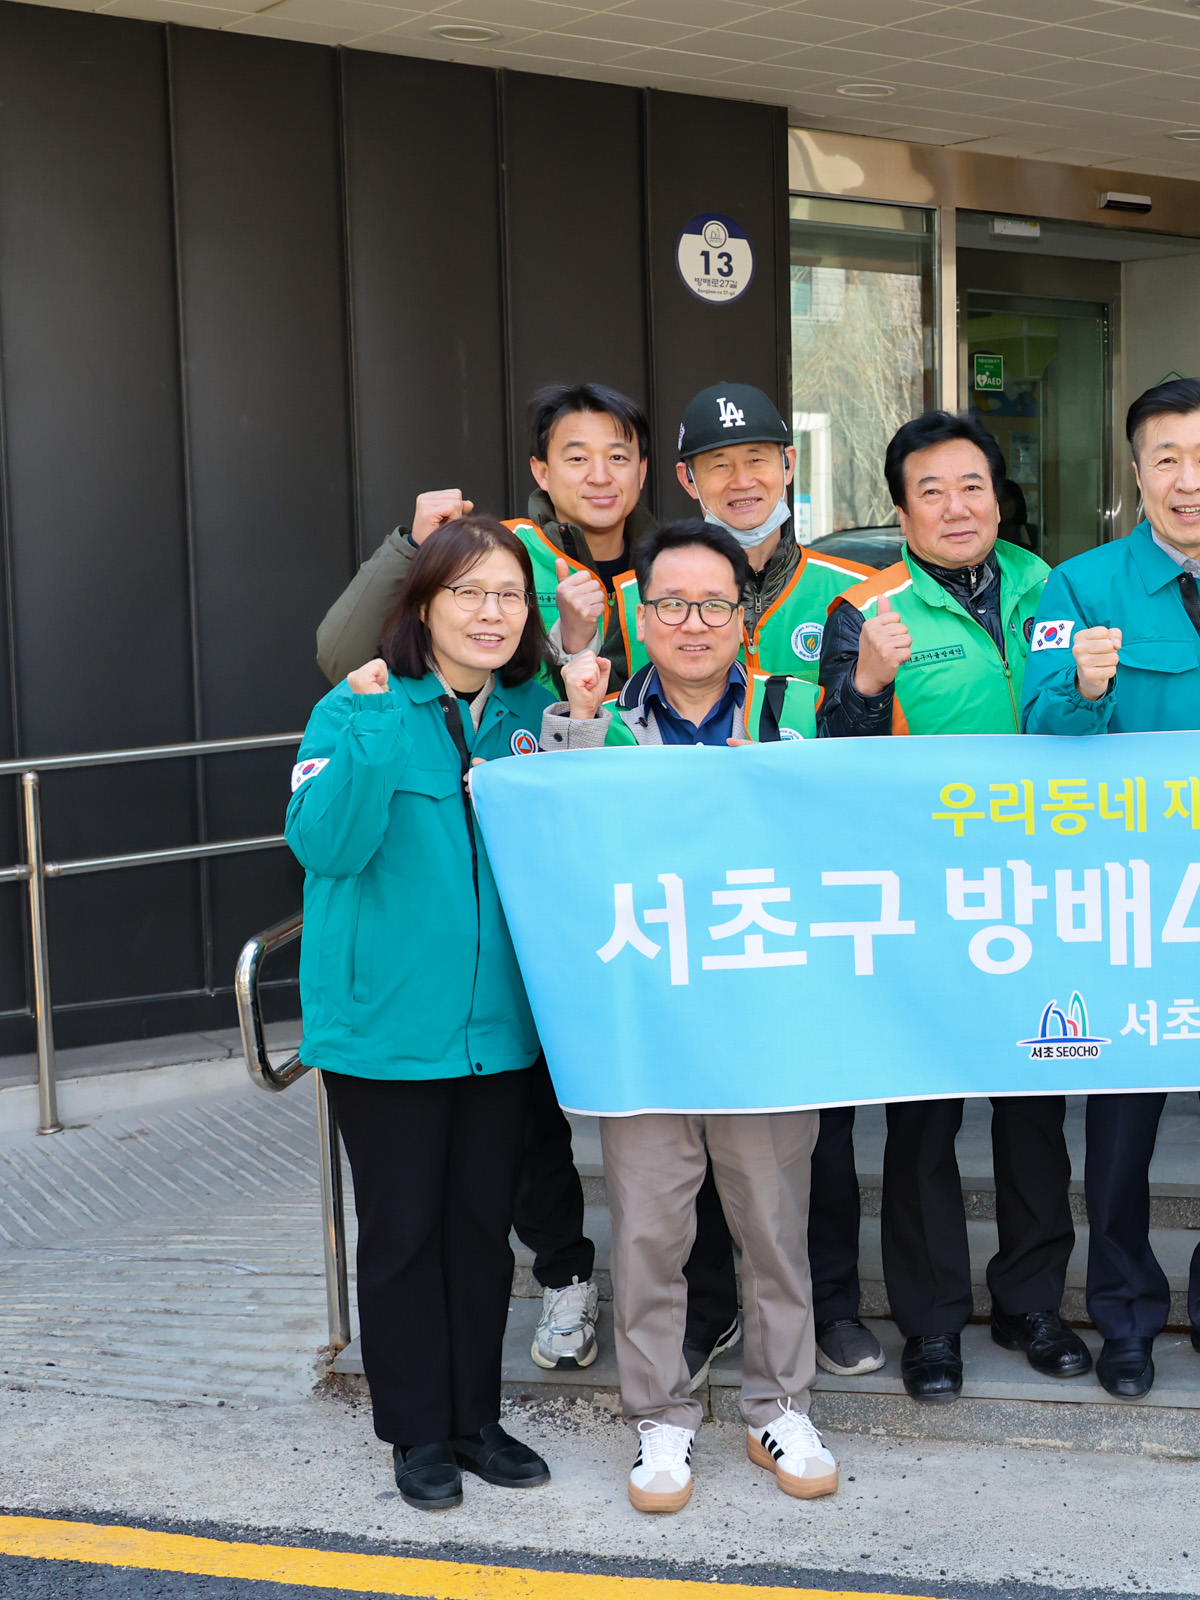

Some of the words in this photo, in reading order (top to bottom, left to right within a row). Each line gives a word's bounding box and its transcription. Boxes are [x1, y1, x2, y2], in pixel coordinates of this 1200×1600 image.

[700, 250, 734, 278] 13
[694, 277, 738, 289] 방배로27길
[987, 377, 1002, 386] AED
[716, 397, 746, 428] LA
[932, 777, 1147, 837] 우리동네
[596, 867, 916, 986] 서초구
[1031, 1046, 1054, 1058] 서초
[1056, 1046, 1098, 1058] SEOCHO
